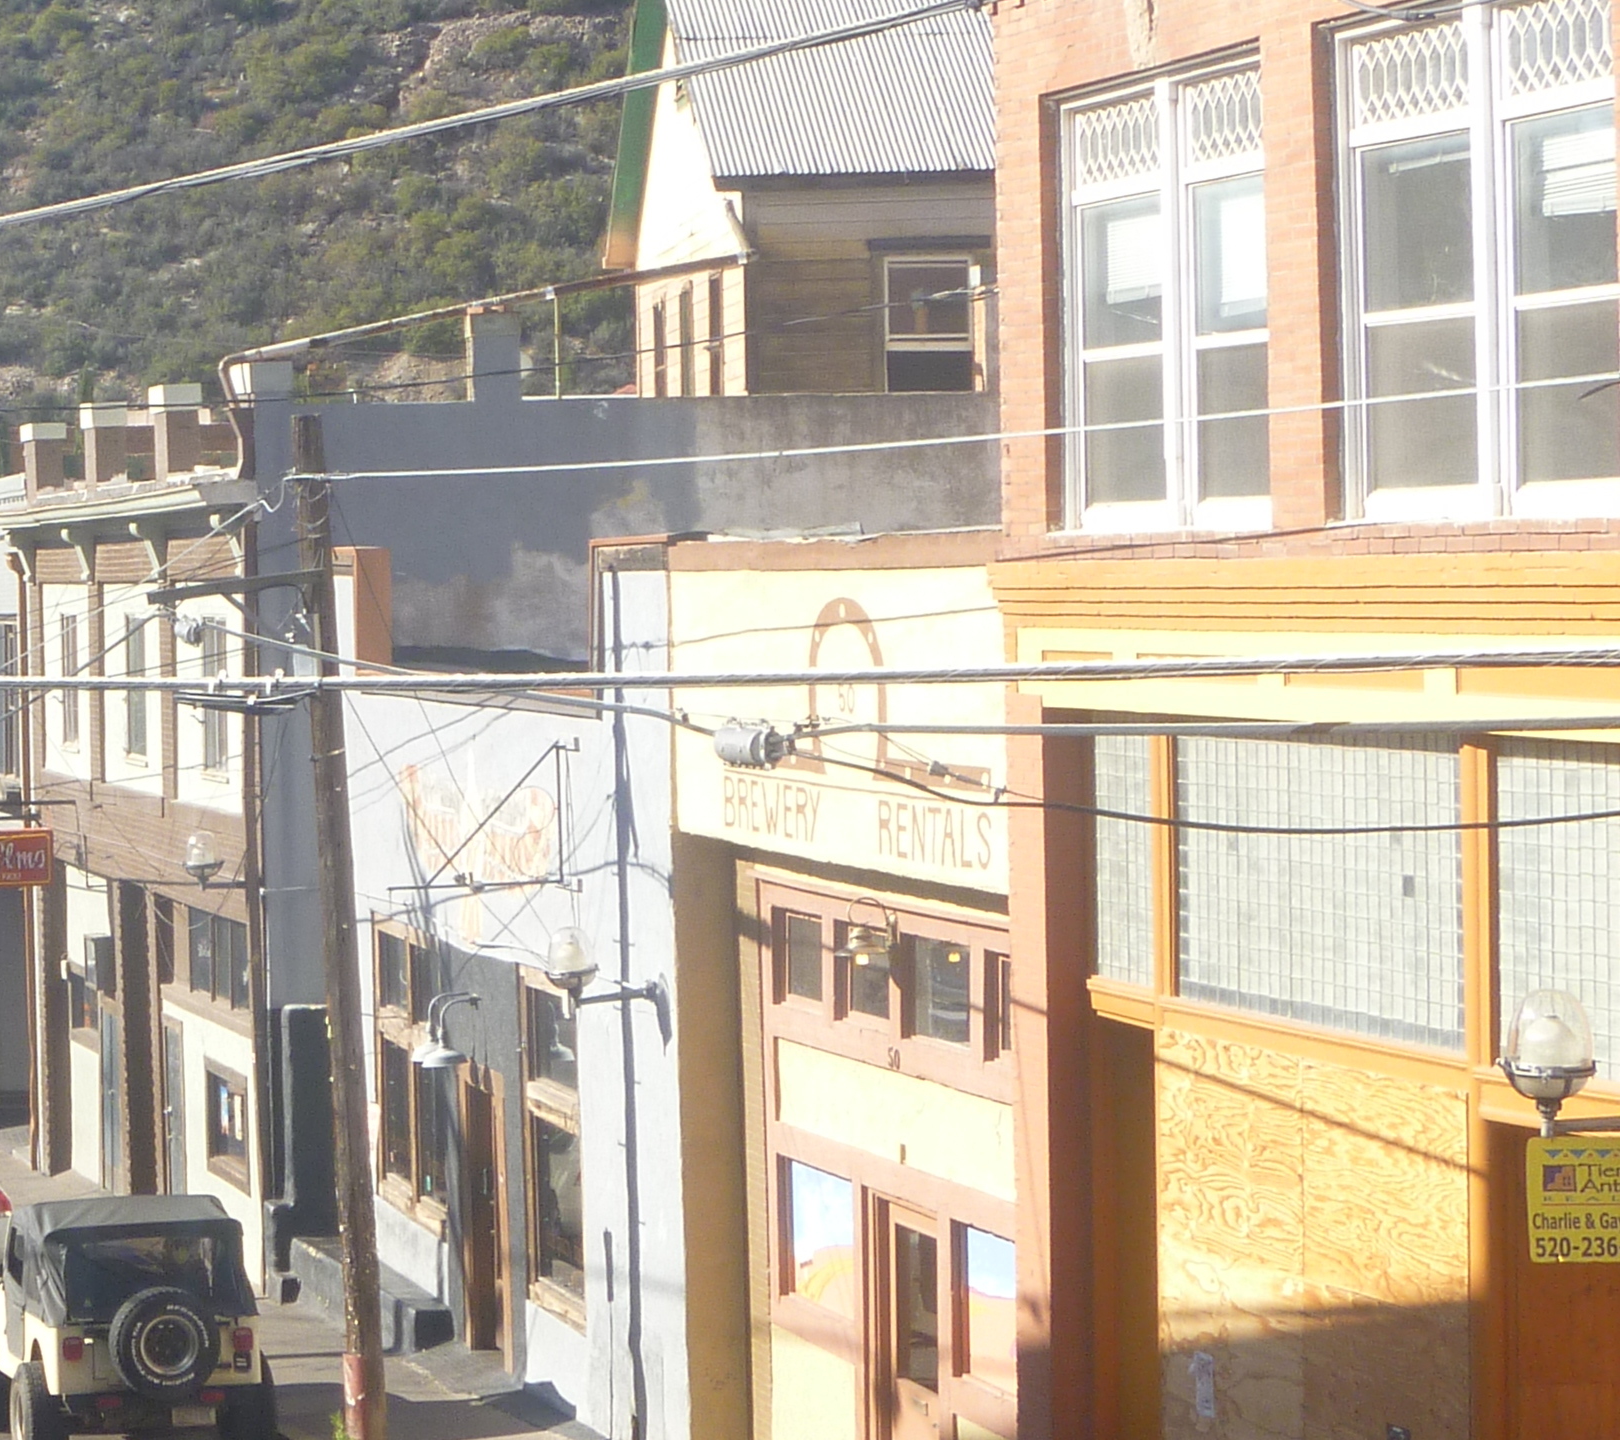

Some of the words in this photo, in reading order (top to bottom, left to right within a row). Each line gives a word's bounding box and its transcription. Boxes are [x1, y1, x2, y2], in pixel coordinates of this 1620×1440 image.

[723, 774, 821, 842] BREWERY
[878, 799, 992, 870] RENTALS
[1532, 1212, 1581, 1229] Charlie
[1585, 1212, 1596, 1229] &
[1535, 1237, 1620, 1258] 520-236
